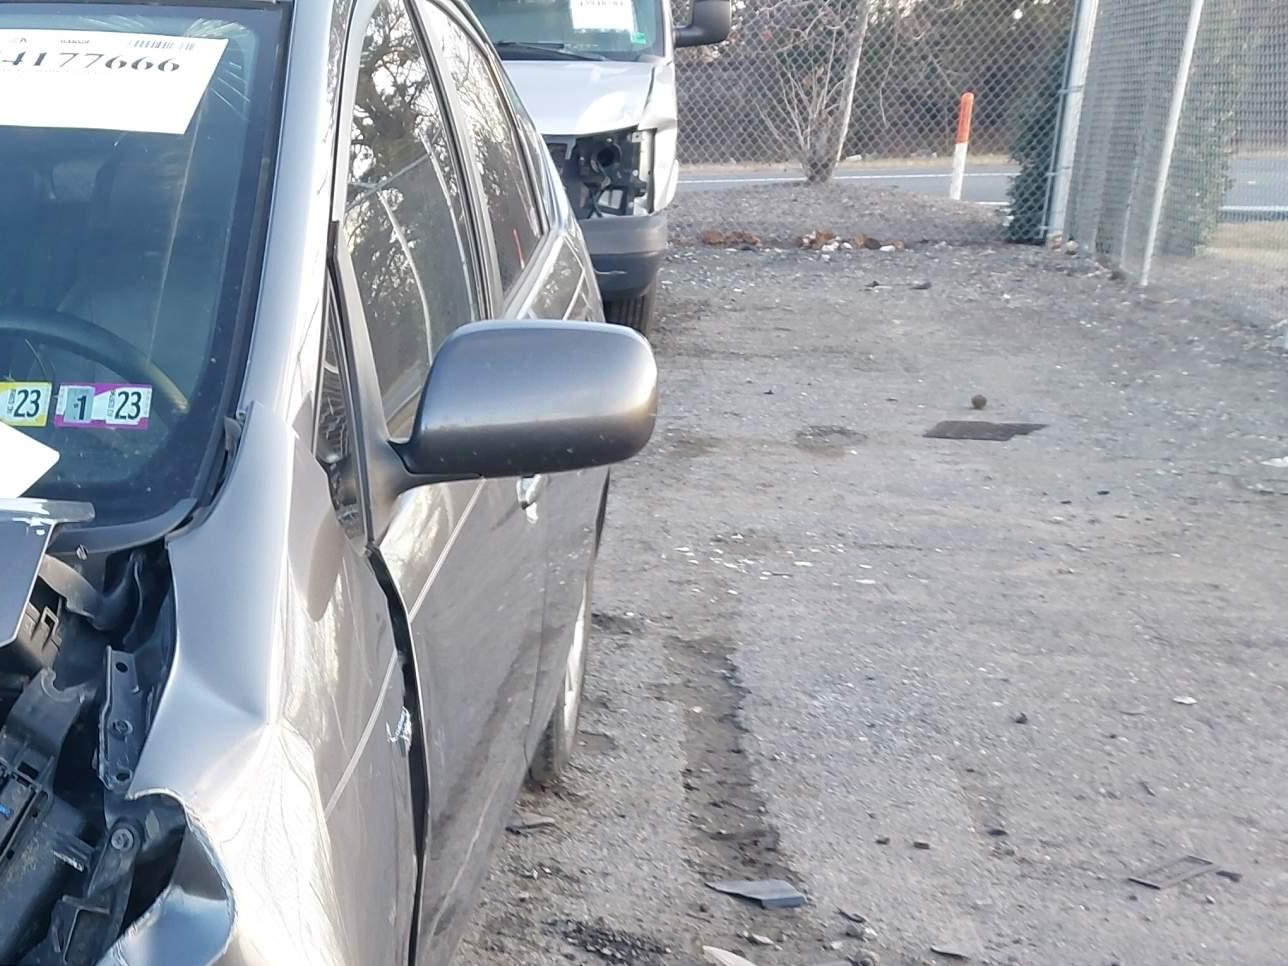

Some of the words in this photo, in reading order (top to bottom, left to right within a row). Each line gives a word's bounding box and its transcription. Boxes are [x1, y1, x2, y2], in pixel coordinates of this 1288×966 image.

[13, 389, 42, 418] 23
[76, 395, 87, 421] 1
[114, 390, 143, 421] 23
